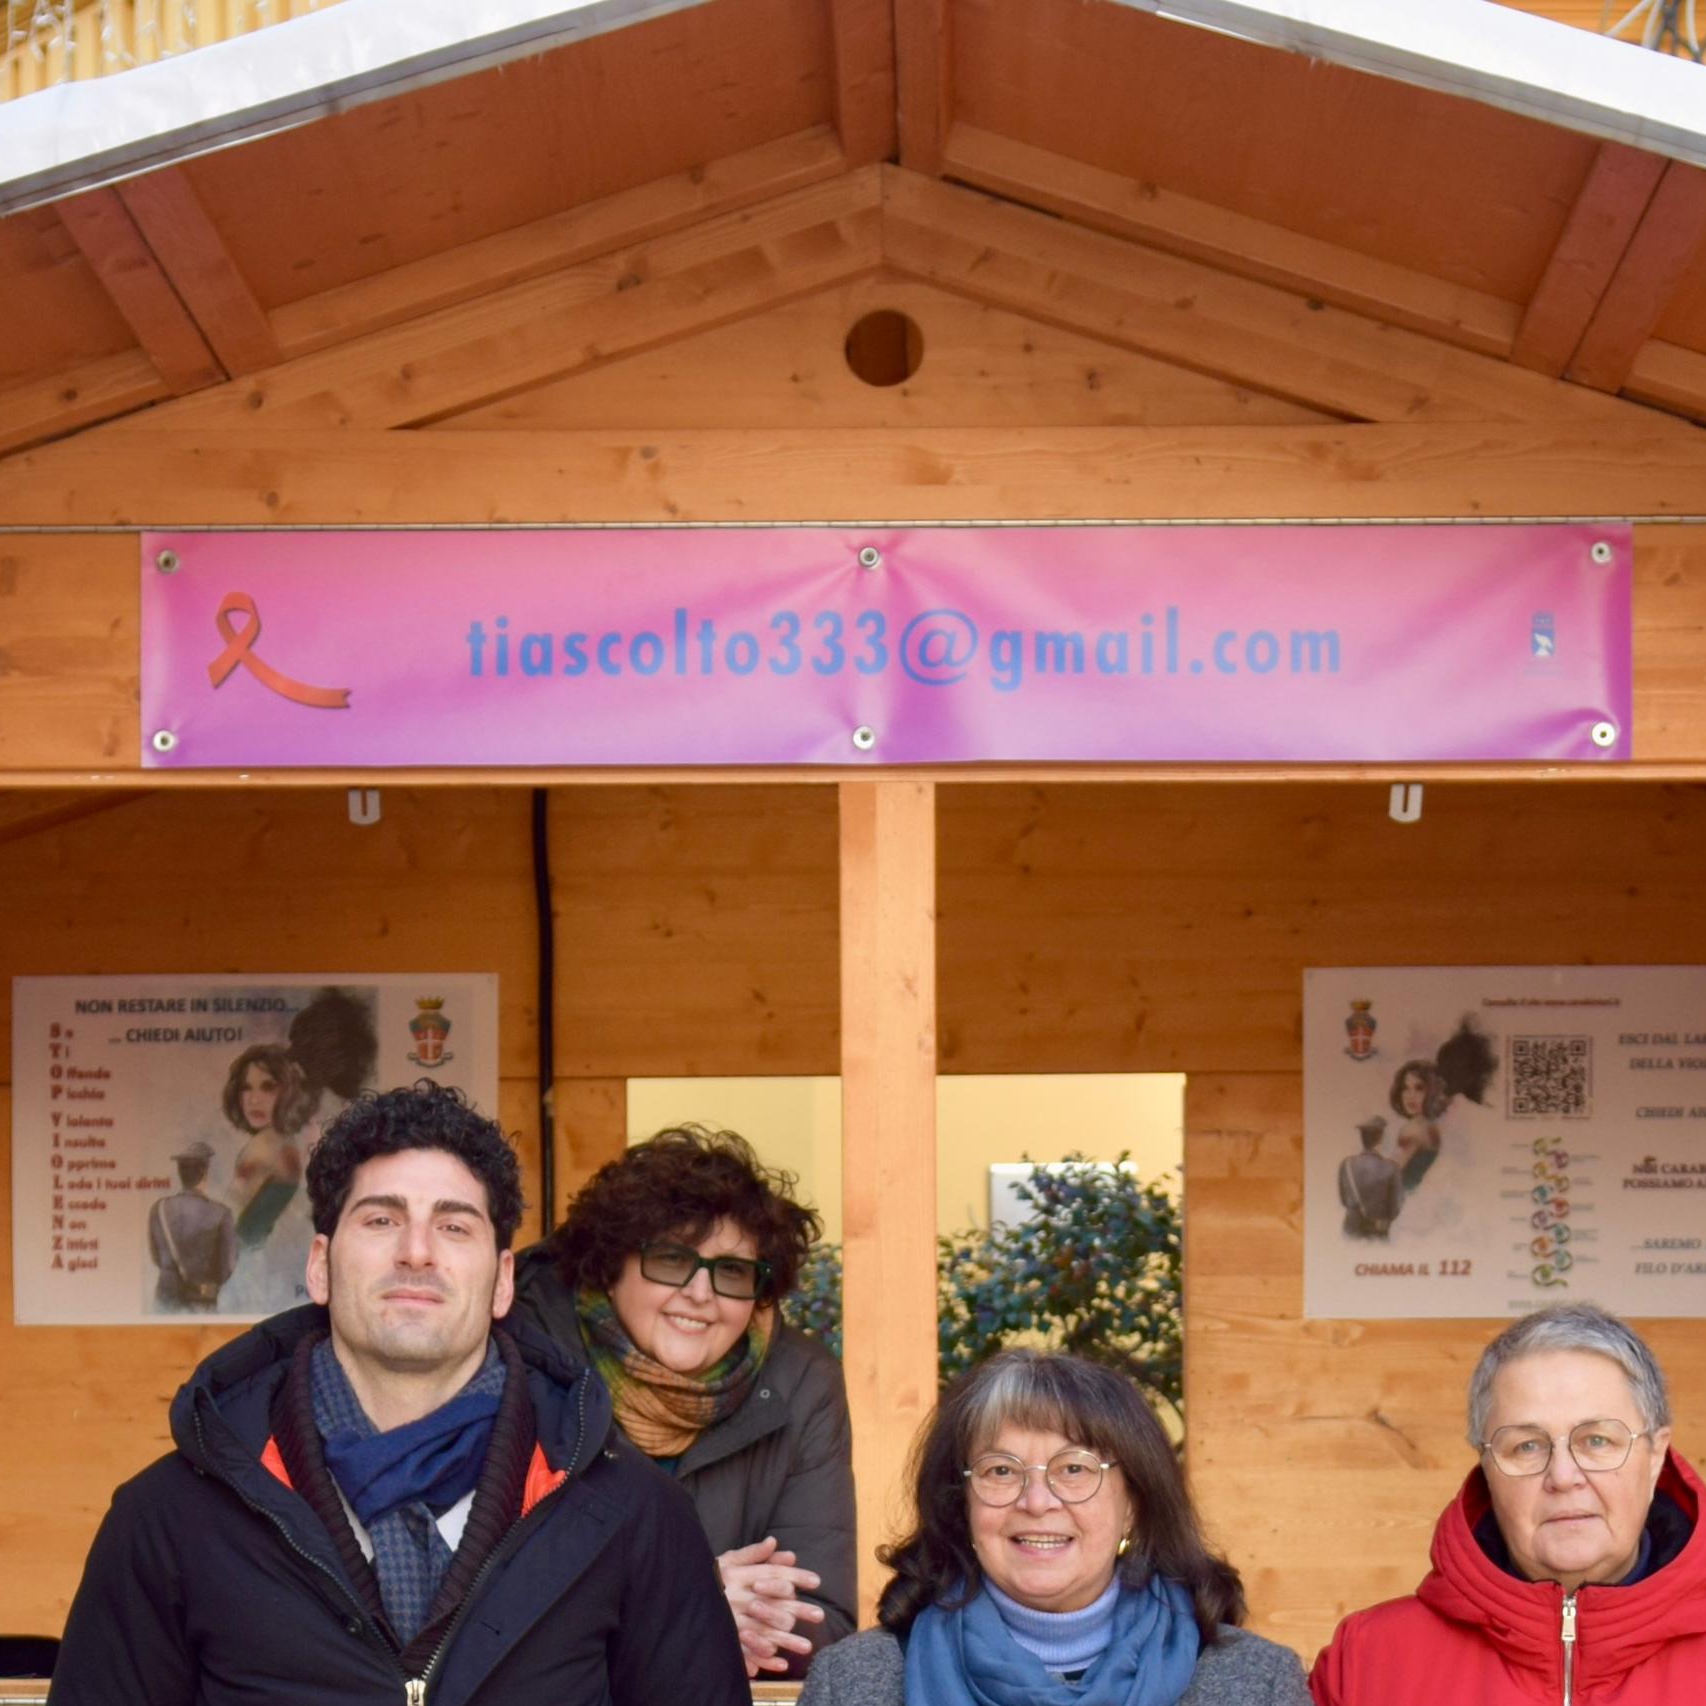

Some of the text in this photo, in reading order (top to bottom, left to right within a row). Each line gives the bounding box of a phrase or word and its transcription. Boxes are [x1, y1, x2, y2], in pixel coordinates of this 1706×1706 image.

[466, 605, 1341, 692] tiascolto333@gmail.com
[75, 999, 113, 1014] NON
[118, 998, 186, 1013] RESTARE
[191, 998, 208, 1013] IN
[126, 1027, 179, 1042] CHIEDI
[184, 1027, 243, 1042] AIUTO!
[1630, 1057, 1673, 1070] DELLA
[1636, 1106, 1684, 1118] CHIEDI
[1354, 1262, 1414, 1277] CHIAMA
[1438, 1259, 1472, 1276] 112
[1635, 1262, 1667, 1274] FILO
